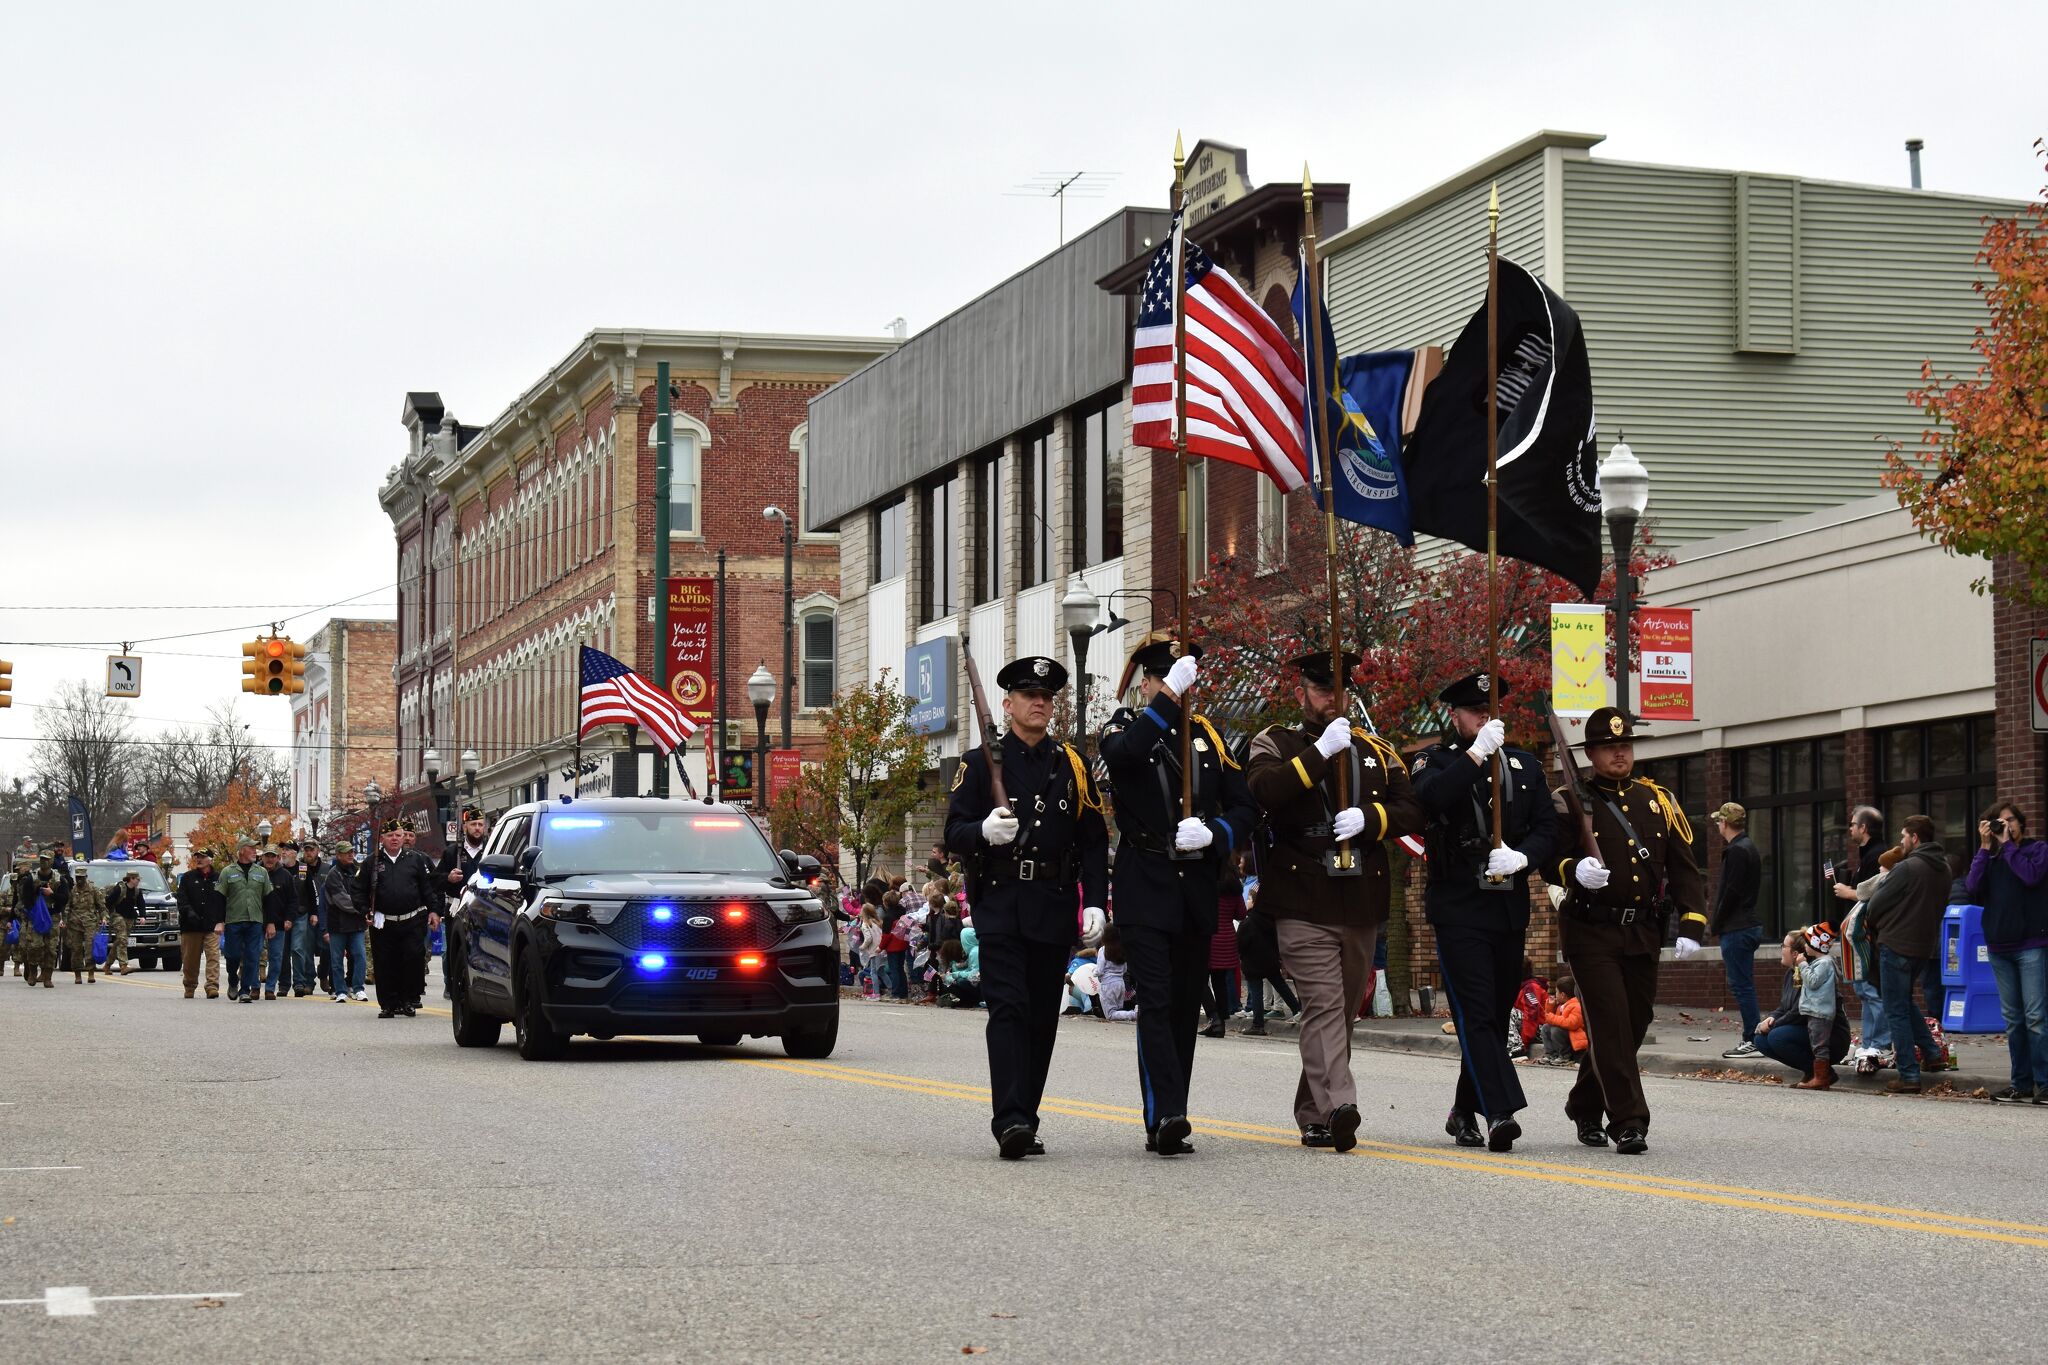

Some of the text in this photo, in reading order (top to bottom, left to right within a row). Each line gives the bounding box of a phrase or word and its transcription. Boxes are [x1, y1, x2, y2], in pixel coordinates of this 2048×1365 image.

[681, 585, 700, 594] BIG
[670, 594, 711, 603] RAPIDS
[673, 622, 707, 636] You'll
[1552, 617, 1571, 631] You
[1643, 617, 1689, 631] Artworks
[671, 636, 707, 649] love it
[677, 649, 704, 663] here!
[1655, 655, 1674, 666] BR
[114, 682, 136, 691] ONLY
[1650, 692, 1675, 701] Festival
[932, 706, 945, 720] BANK
[579, 772, 611, 796] erendipity
[687, 968, 719, 980] 405
